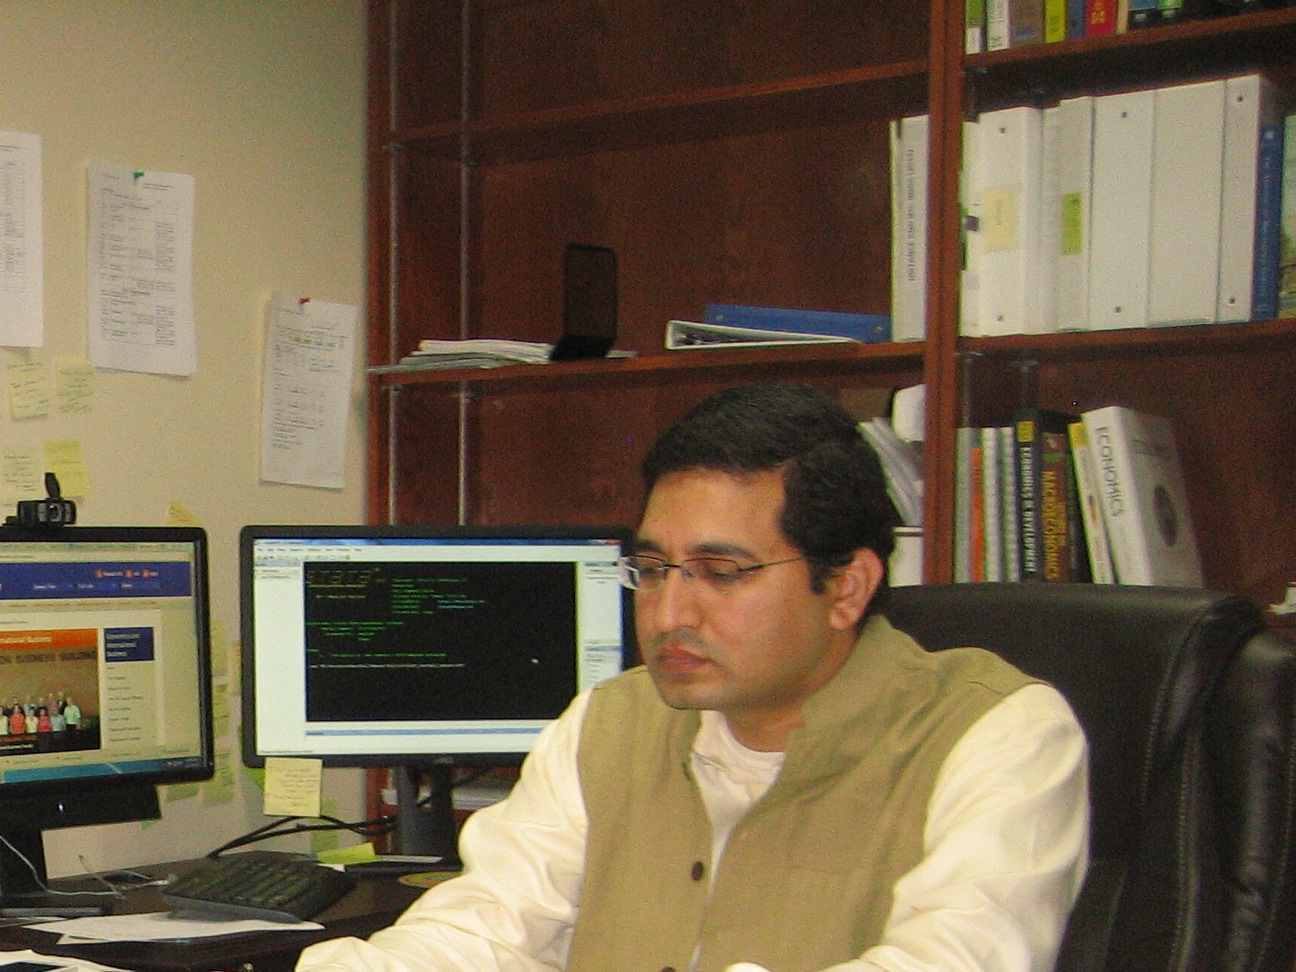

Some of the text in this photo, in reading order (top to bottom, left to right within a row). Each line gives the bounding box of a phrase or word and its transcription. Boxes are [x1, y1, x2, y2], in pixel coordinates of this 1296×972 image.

[1019, 447, 1034, 498] ECONOMICS
[1095, 426, 1124, 517] ECONOMICS
[1022, 510, 1037, 573] DEVELOPMENT
